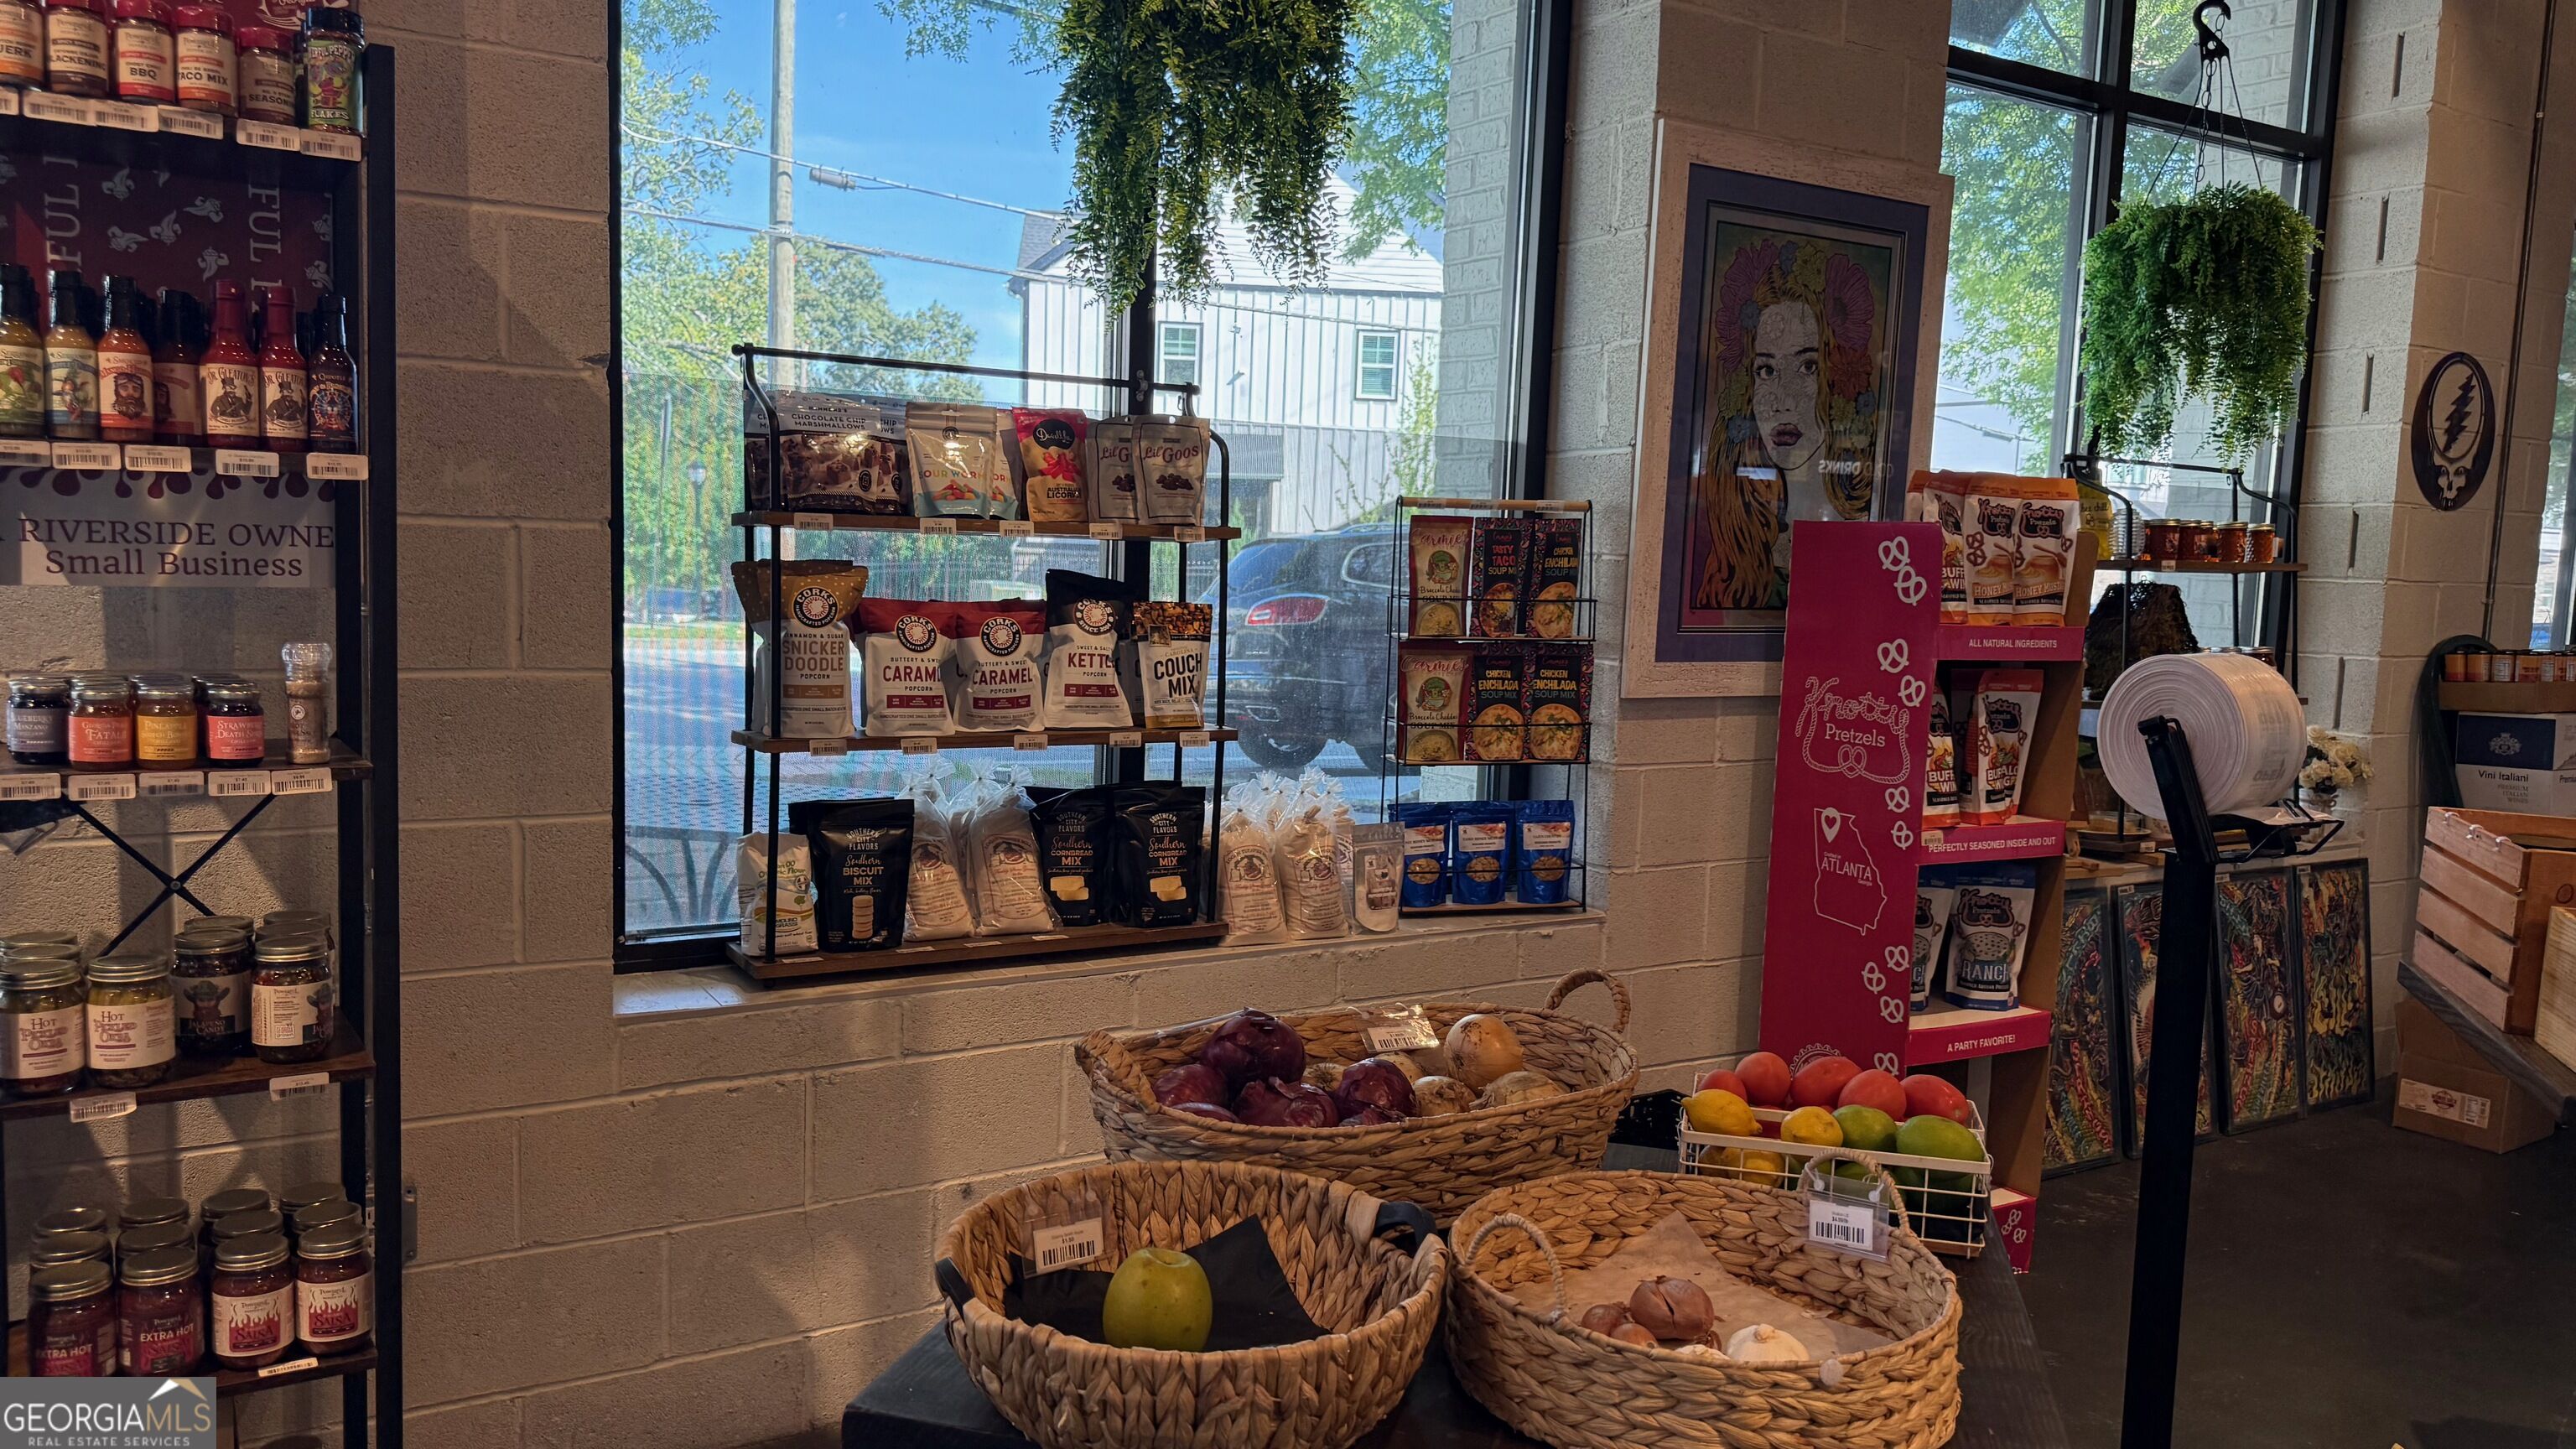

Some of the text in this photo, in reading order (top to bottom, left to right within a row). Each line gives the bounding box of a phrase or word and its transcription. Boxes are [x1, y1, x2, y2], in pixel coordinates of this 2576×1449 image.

[130, 69, 157, 80] BBQ
[207, 74, 228, 86] MIX
[310, 110, 349, 120] FLAKES
[792, 414, 844, 423] CHOCOLATE
[794, 421, 865, 431] MARSHMALLOWS
[18, 517, 334, 549] RIVERSIDE OWNE
[45, 549, 303, 577] Small Business
[1493, 556, 1515, 567] TACO
[1488, 567, 1507, 575] SOUP
[797, 589, 836, 605] CORKS
[1974, 586, 2002, 597] HONEY
[2016, 587, 2043, 597] HONEY
[898, 615, 934, 631] CORKS
[984, 618, 1019, 634] CORKS
[782, 640, 845, 656] SNICKER
[1968, 638, 2058, 649] ALL NATURAL INGREDIENTS
[785, 657, 844, 672] DOODLE
[1154, 652, 1202, 680] COUCH
[973, 667, 1033, 686] CARAMEL
[1485, 670, 1511, 678] CHICKEN
[1540, 669, 1568, 678] CHICKEN
[1168, 674, 1196, 699] MIX
[1478, 680, 1519, 691] ENCHILADA
[1533, 679, 1577, 691] ENCHILADA
[1481, 690, 1502, 699] SOUP
[1535, 689, 1575, 699] SOUP MIX
[1825, 723, 1886, 748] Pretzels
[2478, 769, 2529, 783] Vini Italiani
[1052, 836, 1093, 849] Southern
[1148, 836, 1187, 851] Southern
[1929, 837, 2057, 853] PERFECTLY SEASONED INSIDE AND OUT
[1149, 849, 1187, 858] CORNBREAD
[844, 854, 883, 867] Southern
[1062, 856, 1082, 865] MIX
[1158, 856, 1178, 866] MIX
[843, 866, 885, 875] BISCUIT
[1821, 857, 1873, 881] ATLANTA
[853, 877, 873, 886] MIX
[101, 1010, 125, 1022] HOT
[32, 1017, 57, 1031] HOT
[1947, 1034, 2016, 1053] A PARTY FAVORITE!
[314, 1312, 351, 1327] SALSA
[140, 1322, 195, 1343] EXTRA HOT
[236, 1326, 274, 1342] SALSA
[70, 1343, 93, 1357] HOT
